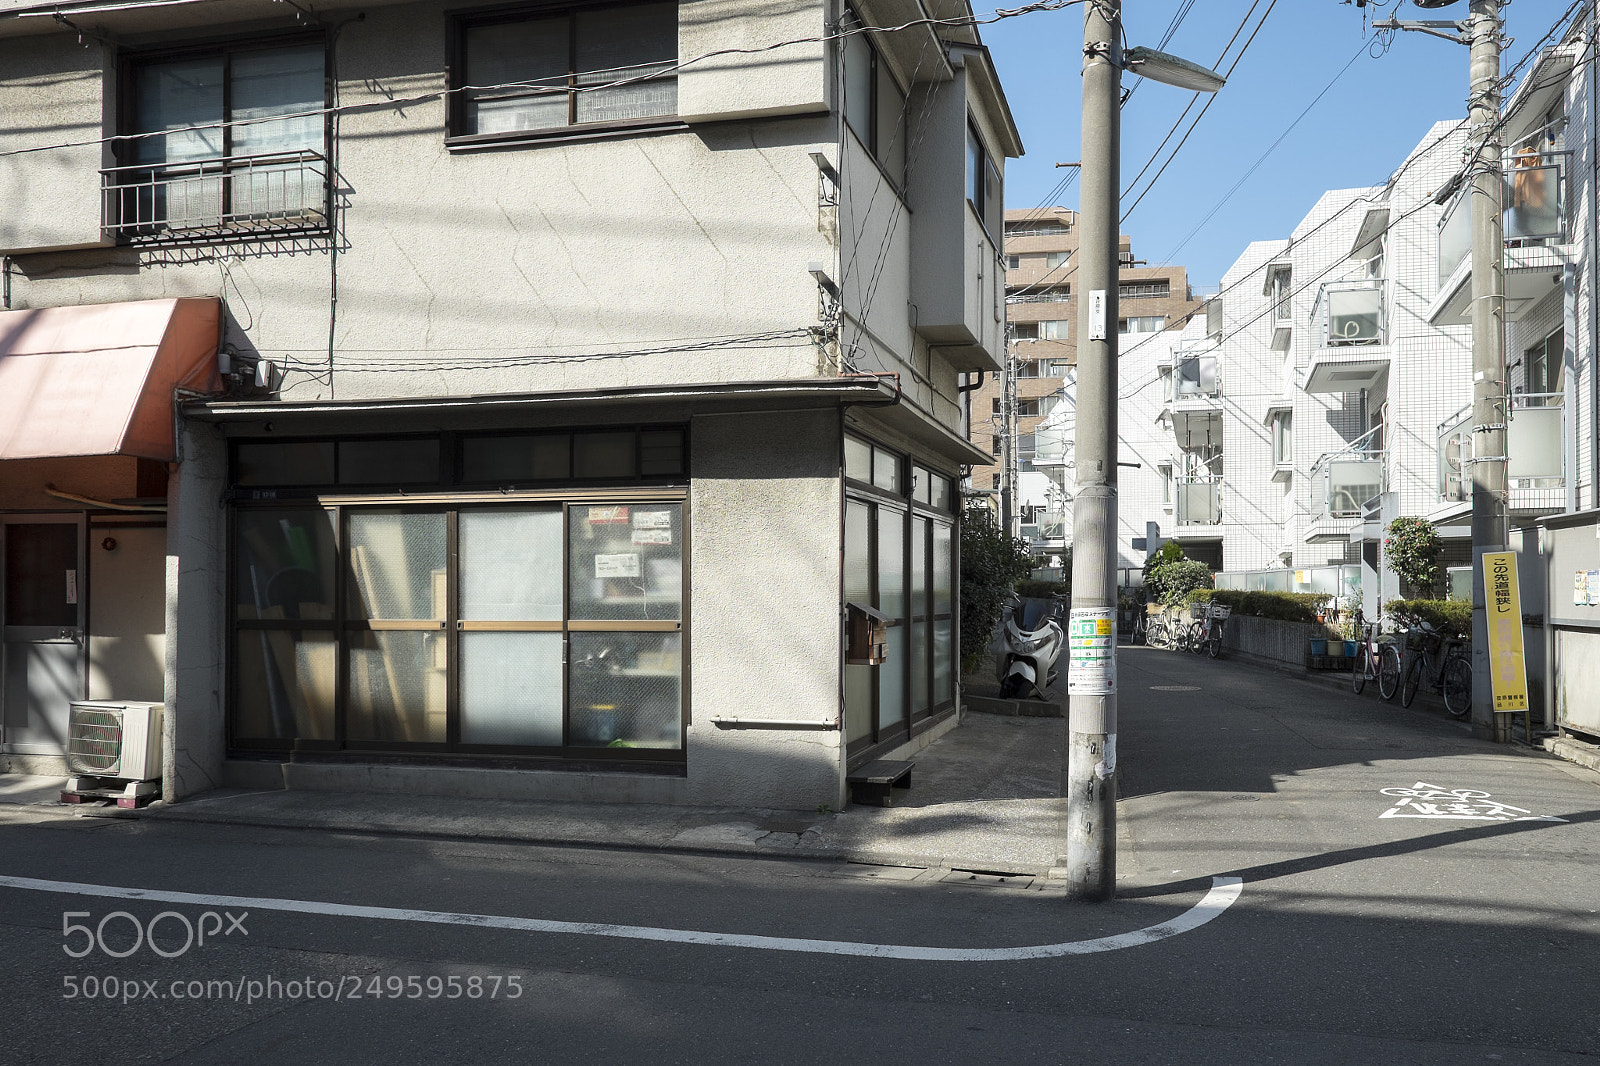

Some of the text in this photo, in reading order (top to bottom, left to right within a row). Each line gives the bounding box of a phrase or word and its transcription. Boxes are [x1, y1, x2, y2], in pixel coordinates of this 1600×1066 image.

[1494, 558, 1511, 613] この先道幅狭し
